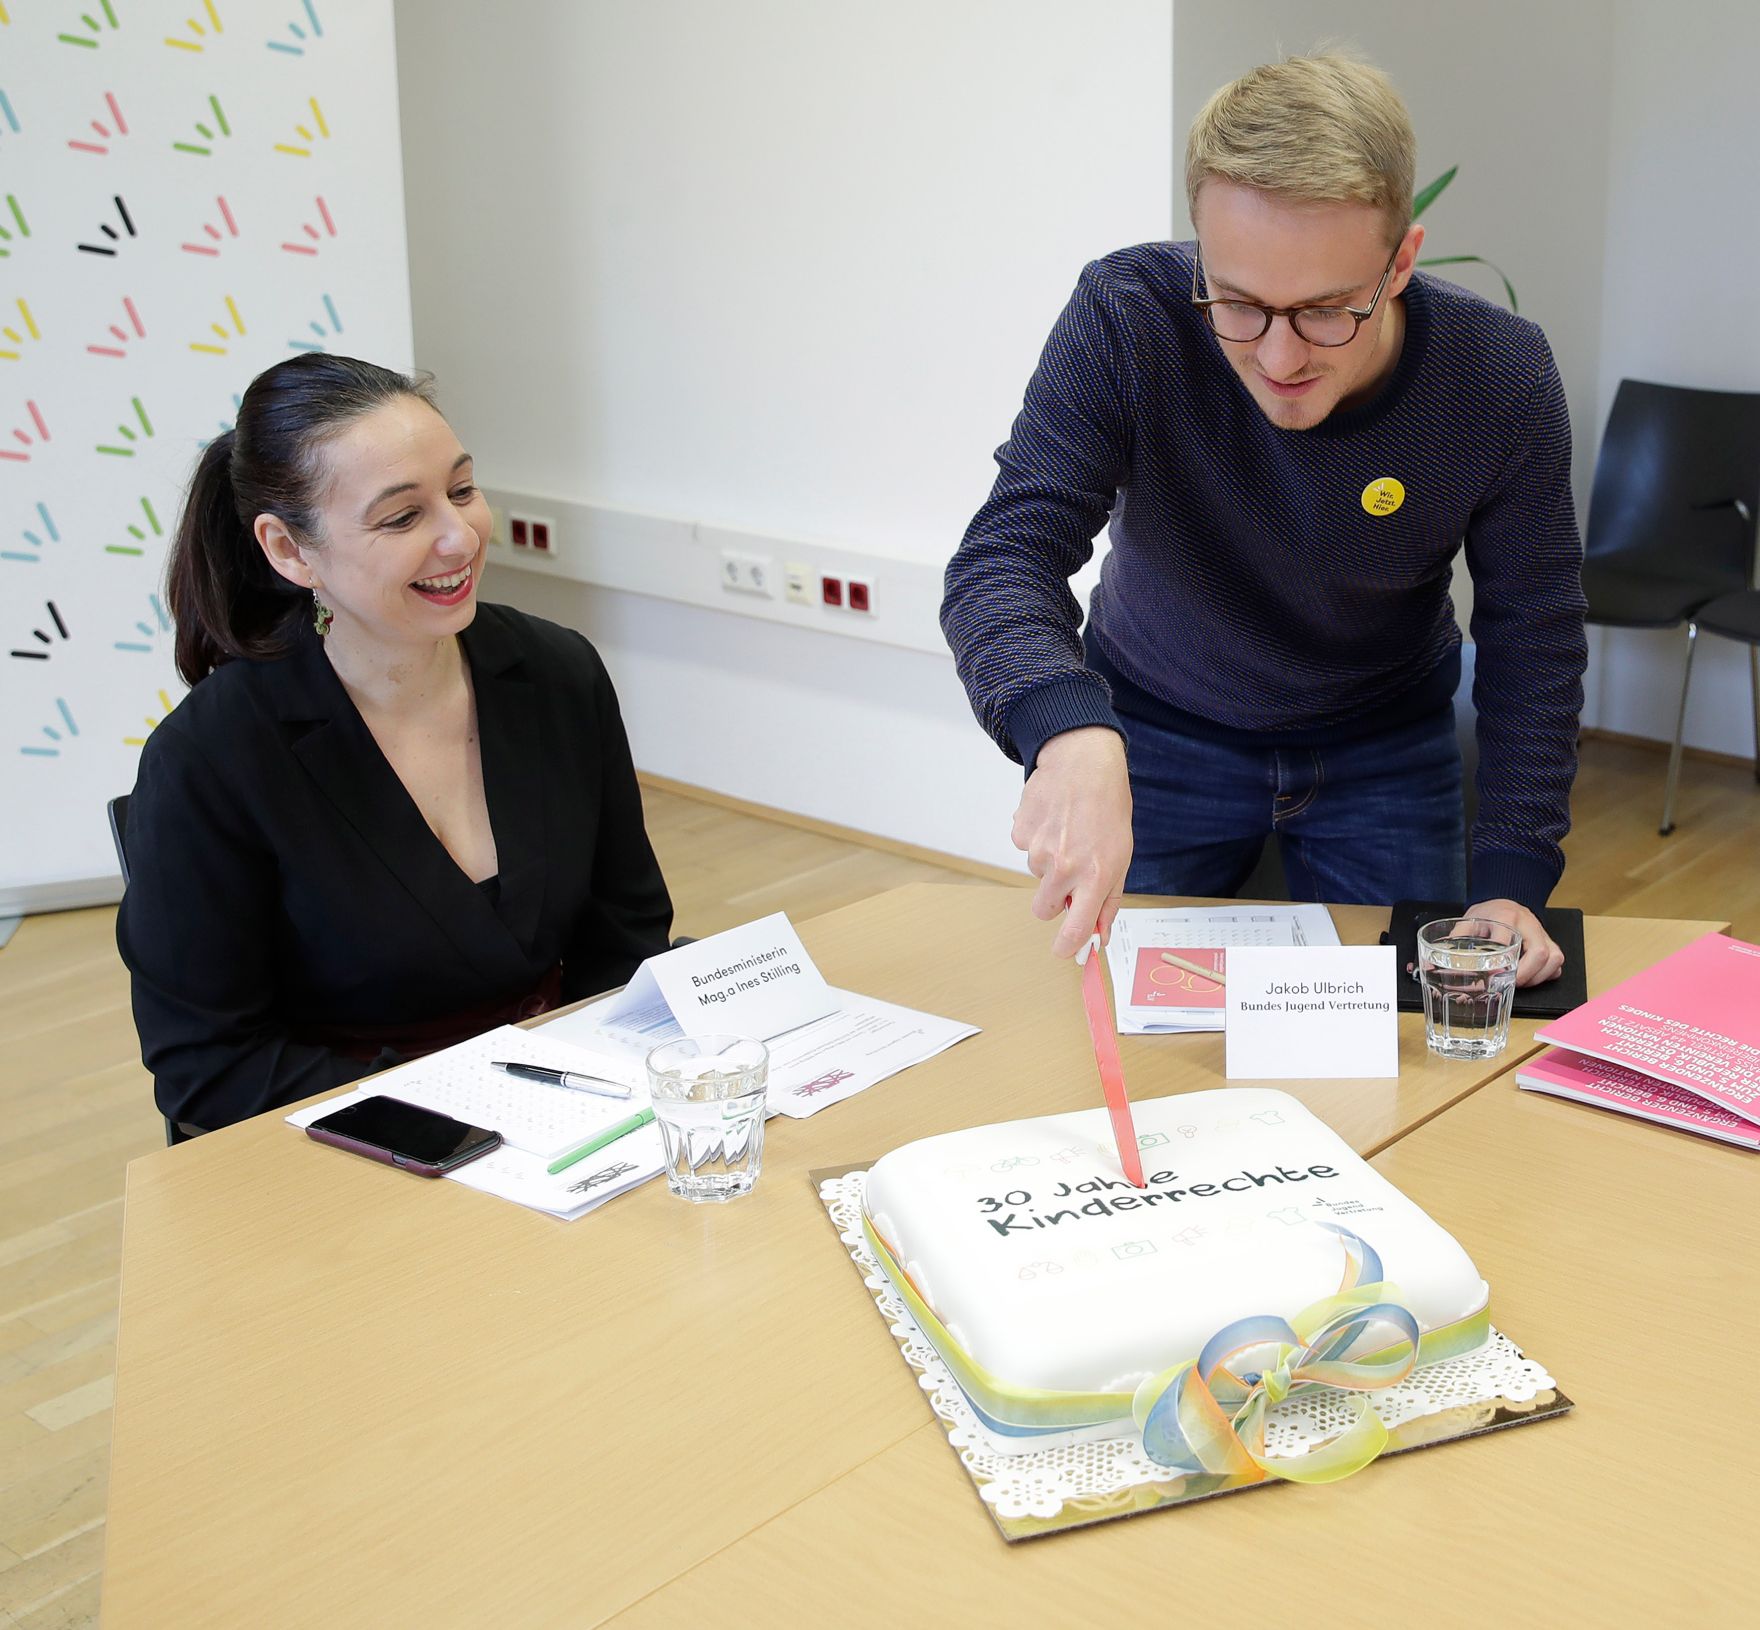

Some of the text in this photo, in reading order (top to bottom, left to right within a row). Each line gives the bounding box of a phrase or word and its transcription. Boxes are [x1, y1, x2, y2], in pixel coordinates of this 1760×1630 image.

[691, 946, 788, 988] Bundesministerin
[697, 962, 801, 1006] Mag.a Ines Stilling
[1265, 981, 1364, 995] Jakob Ulbrich
[1240, 1000, 1390, 1013] Bundes Jugend Vertretung
[1617, 1004, 1760, 1056] DIE RECHTE DES KINDES
[1597, 1018, 1755, 1078] DIE VEREINTEN NATIONEN
[1602, 1043, 1659, 1065] BERICHT
[1615, 1039, 1671, 1061] BERICHT
[1676, 1052, 1740, 1080] REPUBLIK
[1685, 1063, 1715, 1078] UND
[1584, 1082, 1642, 1102] BERICHT
[1596, 1078, 1653, 1098] BERICHT
[1729, 1081, 1760, 1099] ZUM
[1668, 1099, 1698, 1111] UND
[976, 1168, 1180, 1214] 30 Jahe
[986, 1163, 1341, 1237] Kinderrechte
